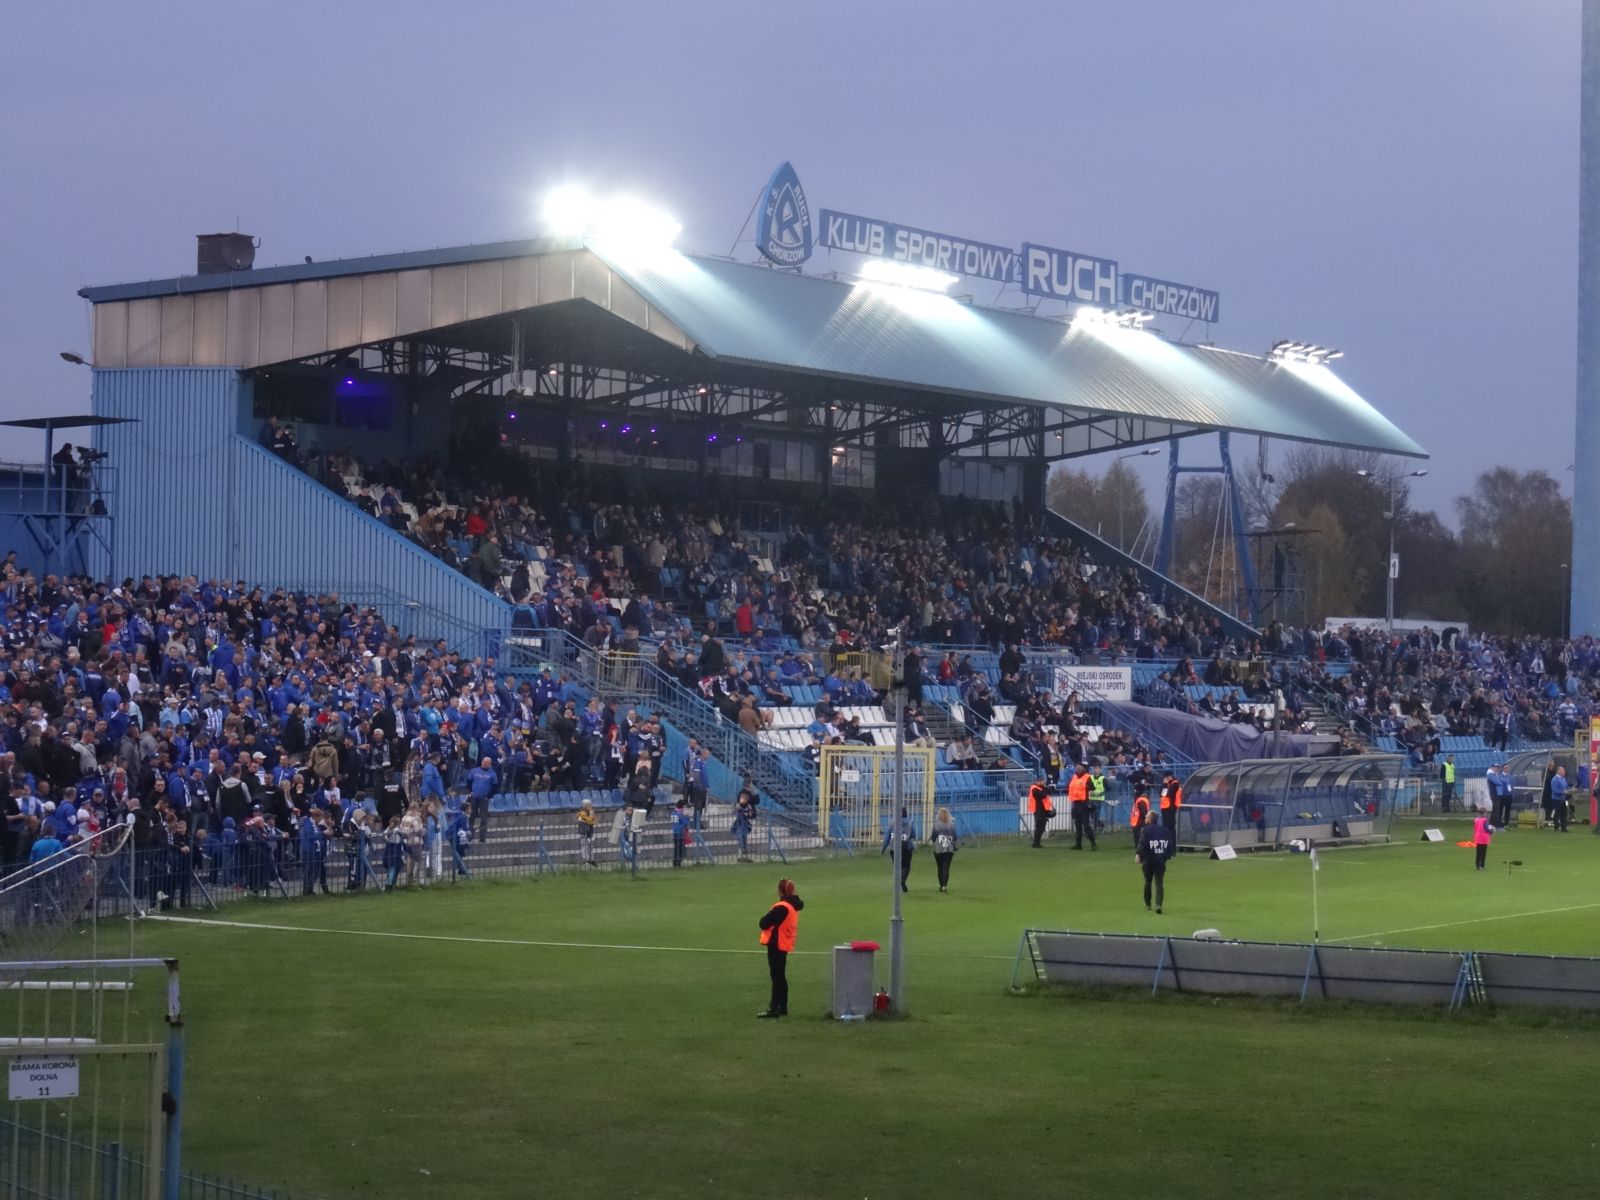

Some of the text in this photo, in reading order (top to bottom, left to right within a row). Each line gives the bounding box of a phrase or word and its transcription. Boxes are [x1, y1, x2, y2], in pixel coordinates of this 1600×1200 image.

[793, 184, 809, 227] RUCH
[828, 215, 1013, 281] KLUB SPORTOWY
[1028, 247, 1217, 321] RUCH CHORZÓW
[1077, 670, 1123, 680] MIEJSKI OŚRODEK
[1106, 681, 1126, 690] SPORTU
[1159, 840, 1168, 849] TV
[11, 1062, 77, 1072] BRAMA KORONA
[30, 1073, 58, 1081] DOLNA
[38, 1087, 50, 1096] 11
